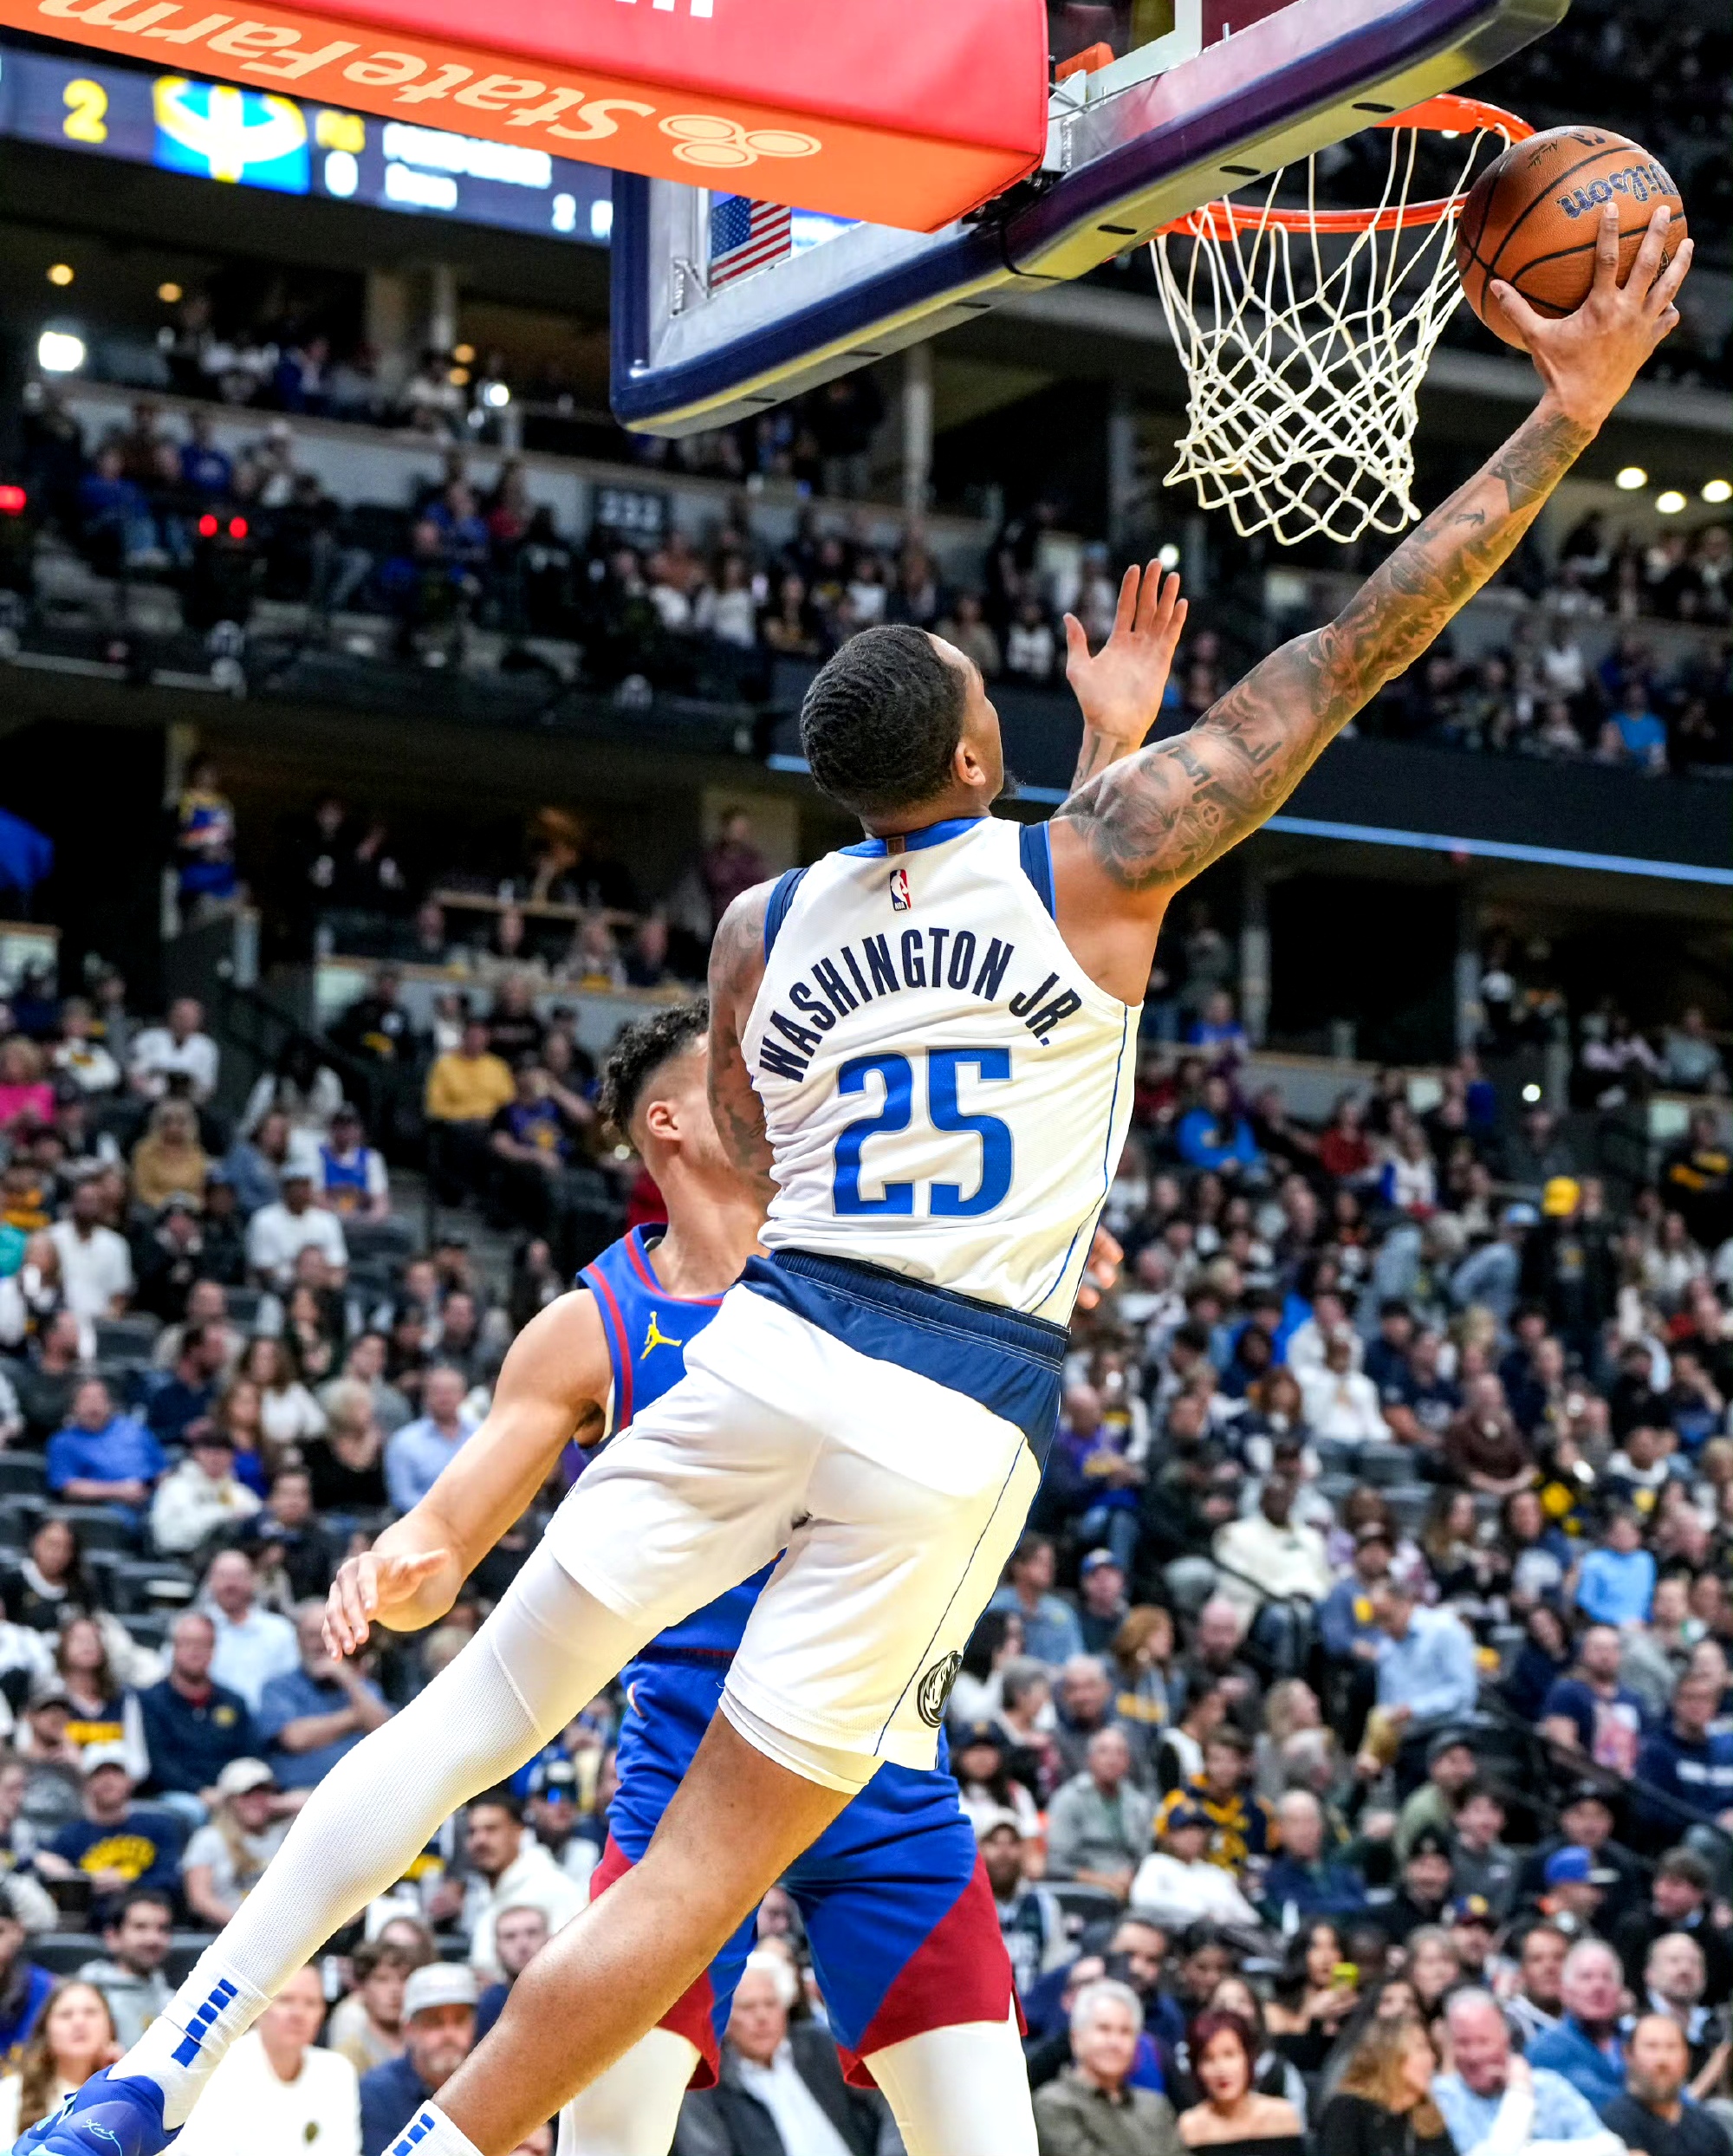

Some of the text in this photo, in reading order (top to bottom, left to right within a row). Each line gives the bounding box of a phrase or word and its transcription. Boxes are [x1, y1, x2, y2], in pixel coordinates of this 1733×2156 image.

[63, 78, 108, 144] 2
[759, 927, 1082, 1083] WASHINGTON JR.
[832, 1045, 1015, 1218] 25
